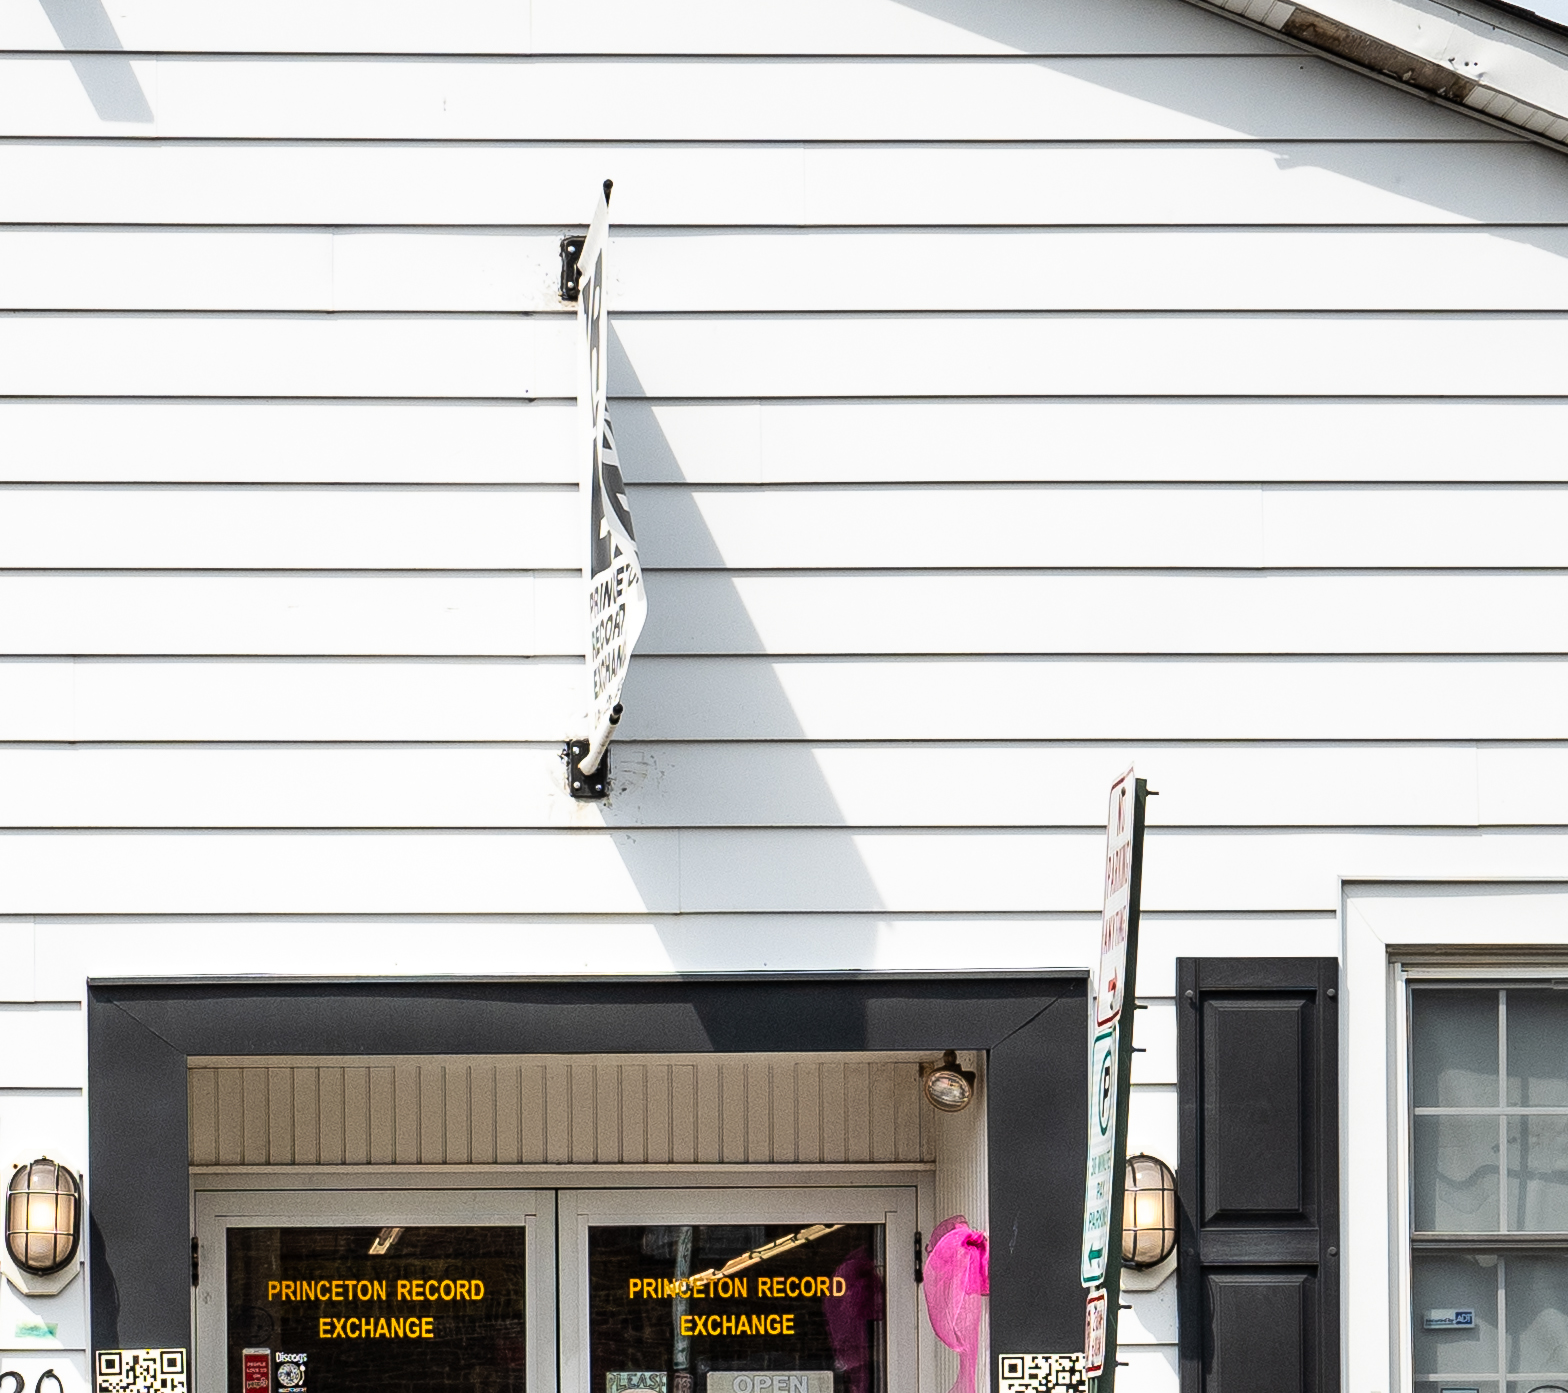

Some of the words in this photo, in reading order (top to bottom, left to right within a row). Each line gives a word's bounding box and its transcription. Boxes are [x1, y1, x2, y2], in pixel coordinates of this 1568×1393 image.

[268, 1279, 387, 1301] PRINCETON
[397, 1279, 485, 1301] RECORD
[629, 1277, 748, 1299] PRINCETON
[757, 1276, 847, 1298] RECORD
[319, 1317, 434, 1339] EXCHANGE
[680, 1314, 795, 1336] EXCHANGE
[1455, 1313, 1473, 1323] ADT
[275, 1351, 308, 1364] Discogs
